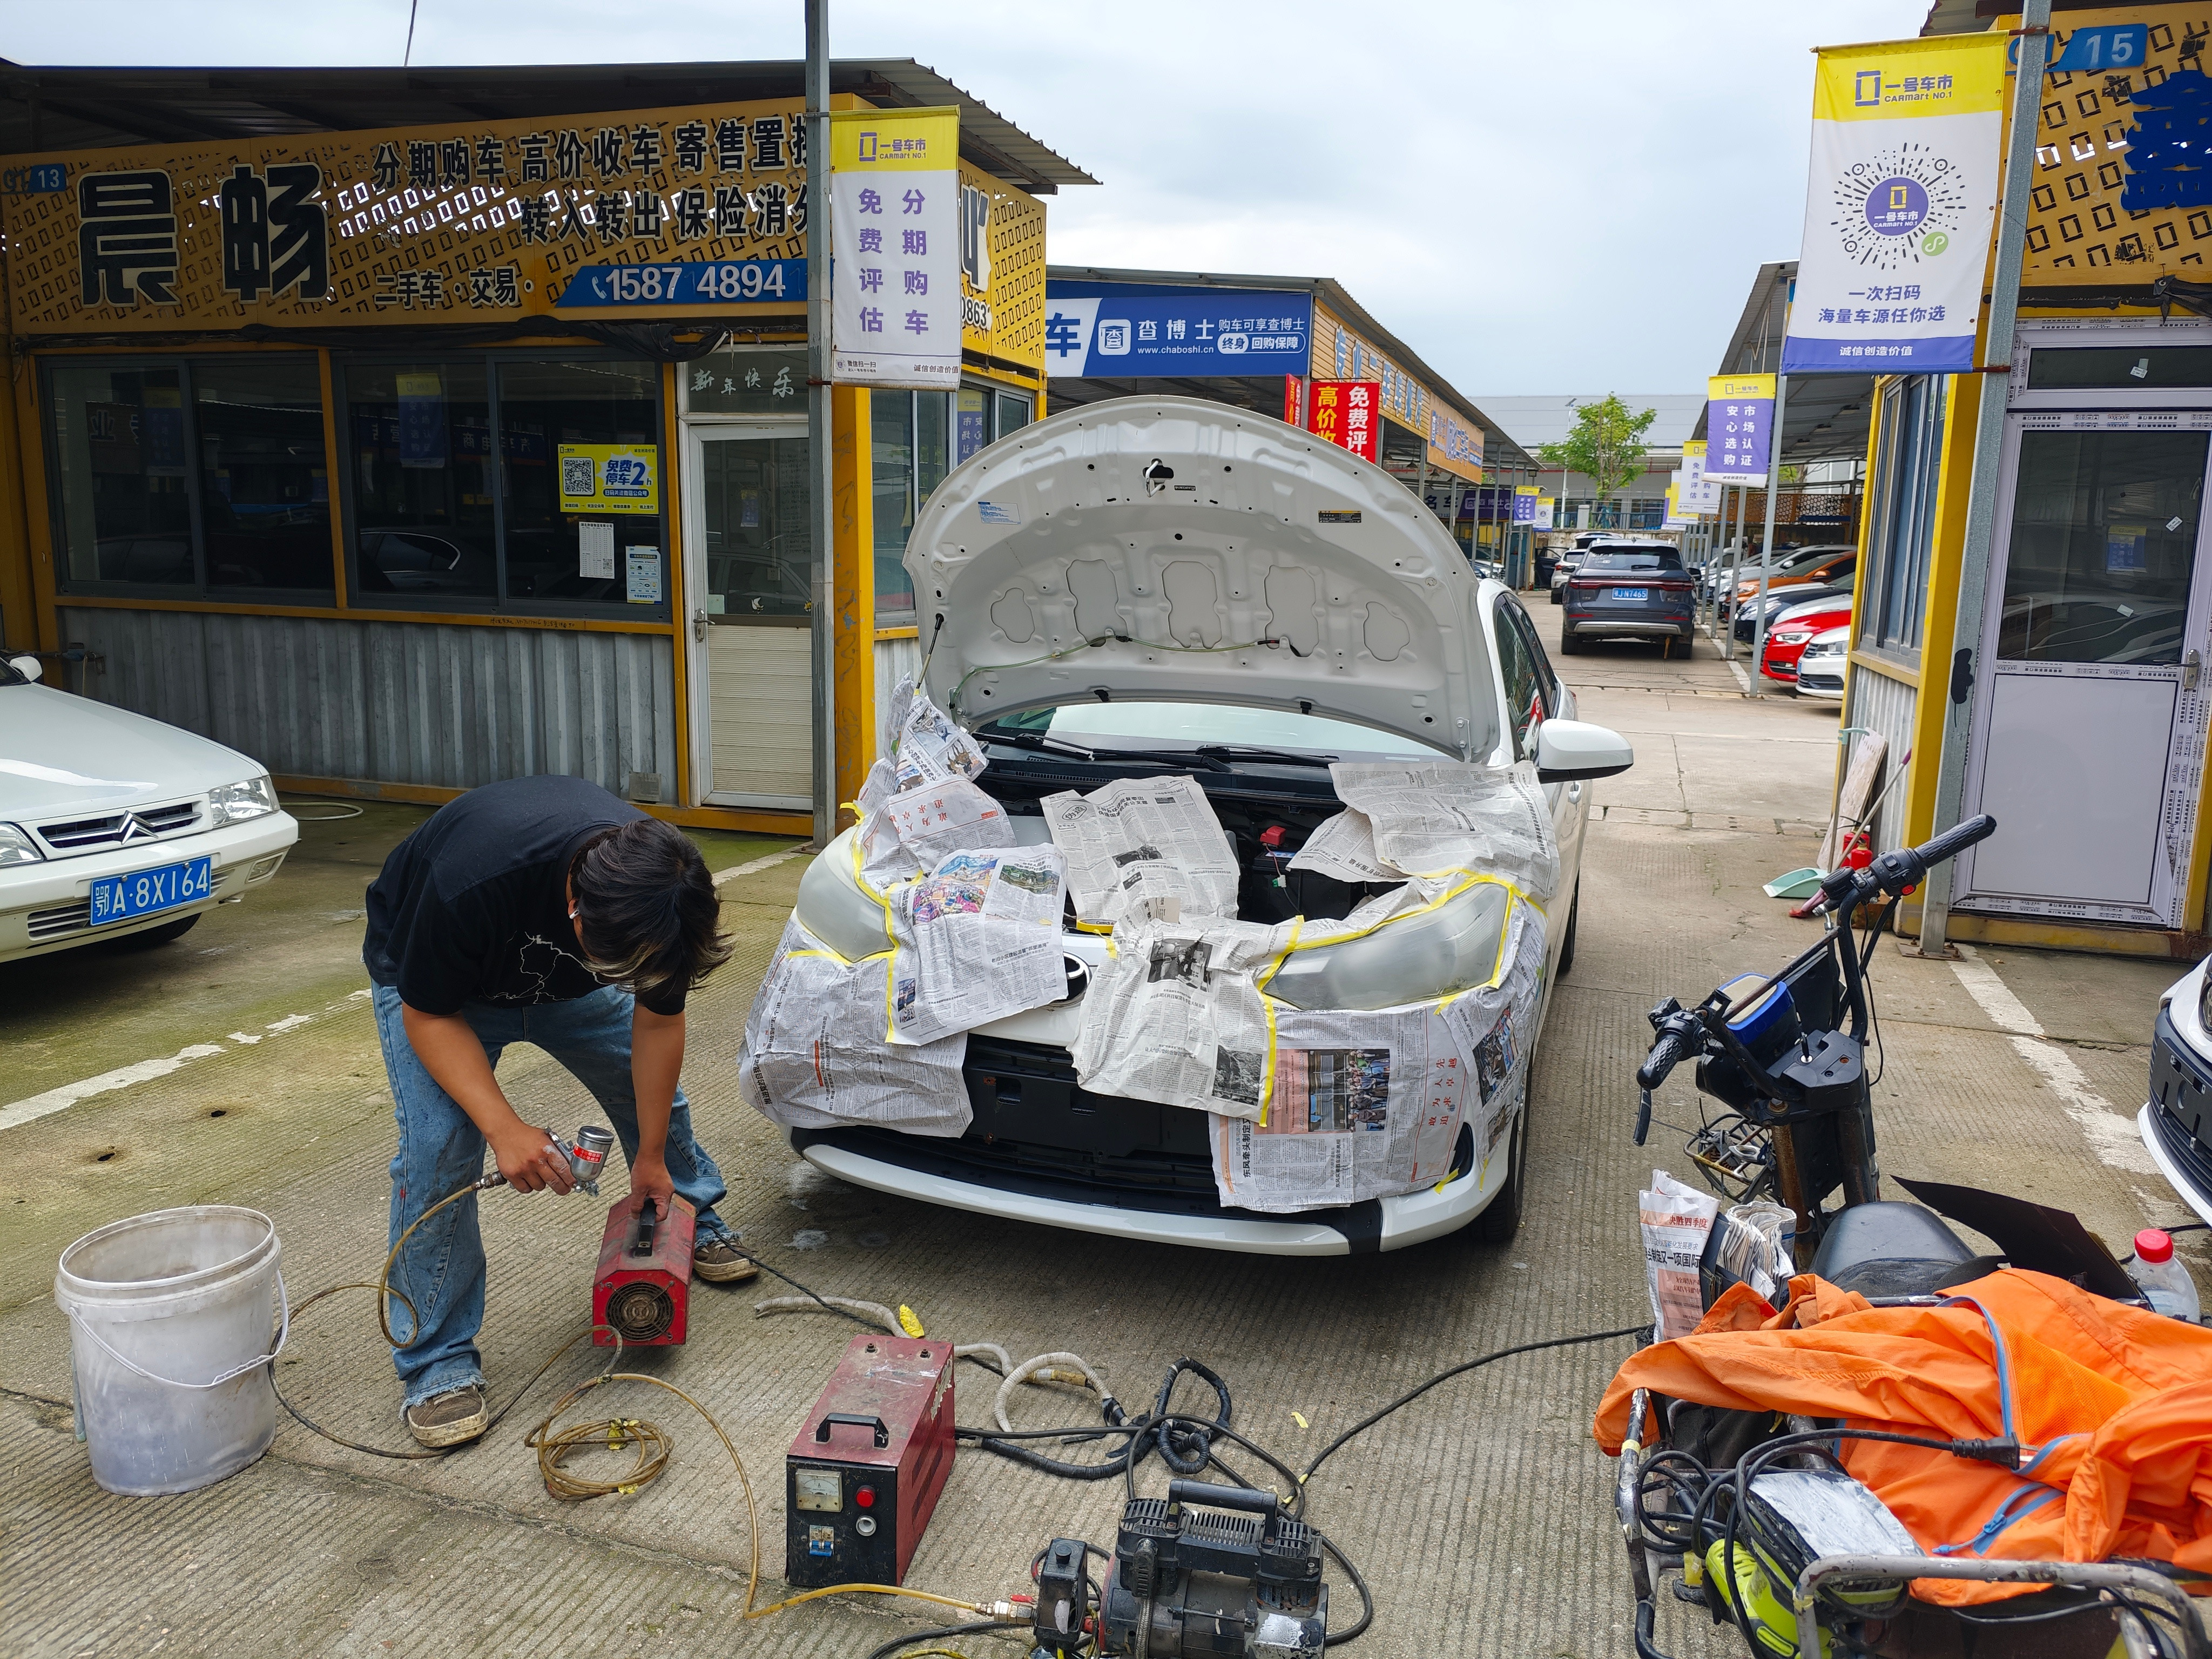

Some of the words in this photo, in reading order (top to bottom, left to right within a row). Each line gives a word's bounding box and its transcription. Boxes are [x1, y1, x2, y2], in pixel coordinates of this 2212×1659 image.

[2086, 32, 2134, 65] 15
[1885, 75, 1953, 93] 一号车市
[1933, 91, 1953, 100] NO.1
[880, 138, 927, 152] 一号车市
[372, 136, 504, 190] 分期购车
[520, 125, 662, 184] 高价收车
[38, 169, 59, 188] 13
[521, 188, 662, 245] 转入转出
[1873, 211, 1919, 222] 一号车市
[1904, 219, 1918, 227] NO.1
[80, 164, 330, 308] 晨畅
[858, 188, 884, 333] 免费评估
[902, 189, 929, 335] 分期购车
[1848, 284, 1921, 301] 一次扫码
[1818, 305, 1946, 324] 海量车源任你选
[1137, 319, 1215, 341] 查博士
[1218, 318, 1305, 332] 购车可享查博士
[1046, 313, 1081, 358] 车
[1222, 337, 1245, 350] 终身
[1251, 336, 1298, 350] 回购保障
[1137, 345, 1214, 355] www.chaboshi.cn
[1839, 345, 1913, 356] 诚信创造价值
[914, 364, 959, 374] 诚信创造价值
[690, 366, 794, 398] 新年快乐
[1346, 386, 1370, 460] 免费评
[1723, 405, 1738, 466] 安心选购
[1740, 405, 1756, 466] 市场认证
[606, 460, 632, 472] 免费
[606, 473, 631, 485] 停车
[1064, 806, 1084, 820] 伪造
[1428, 1058, 1445, 1127] 敢为人先
[1439, 1057, 1457, 1125] 追求卓越
[1669, 1216, 1709, 1229] 决胜四季度
